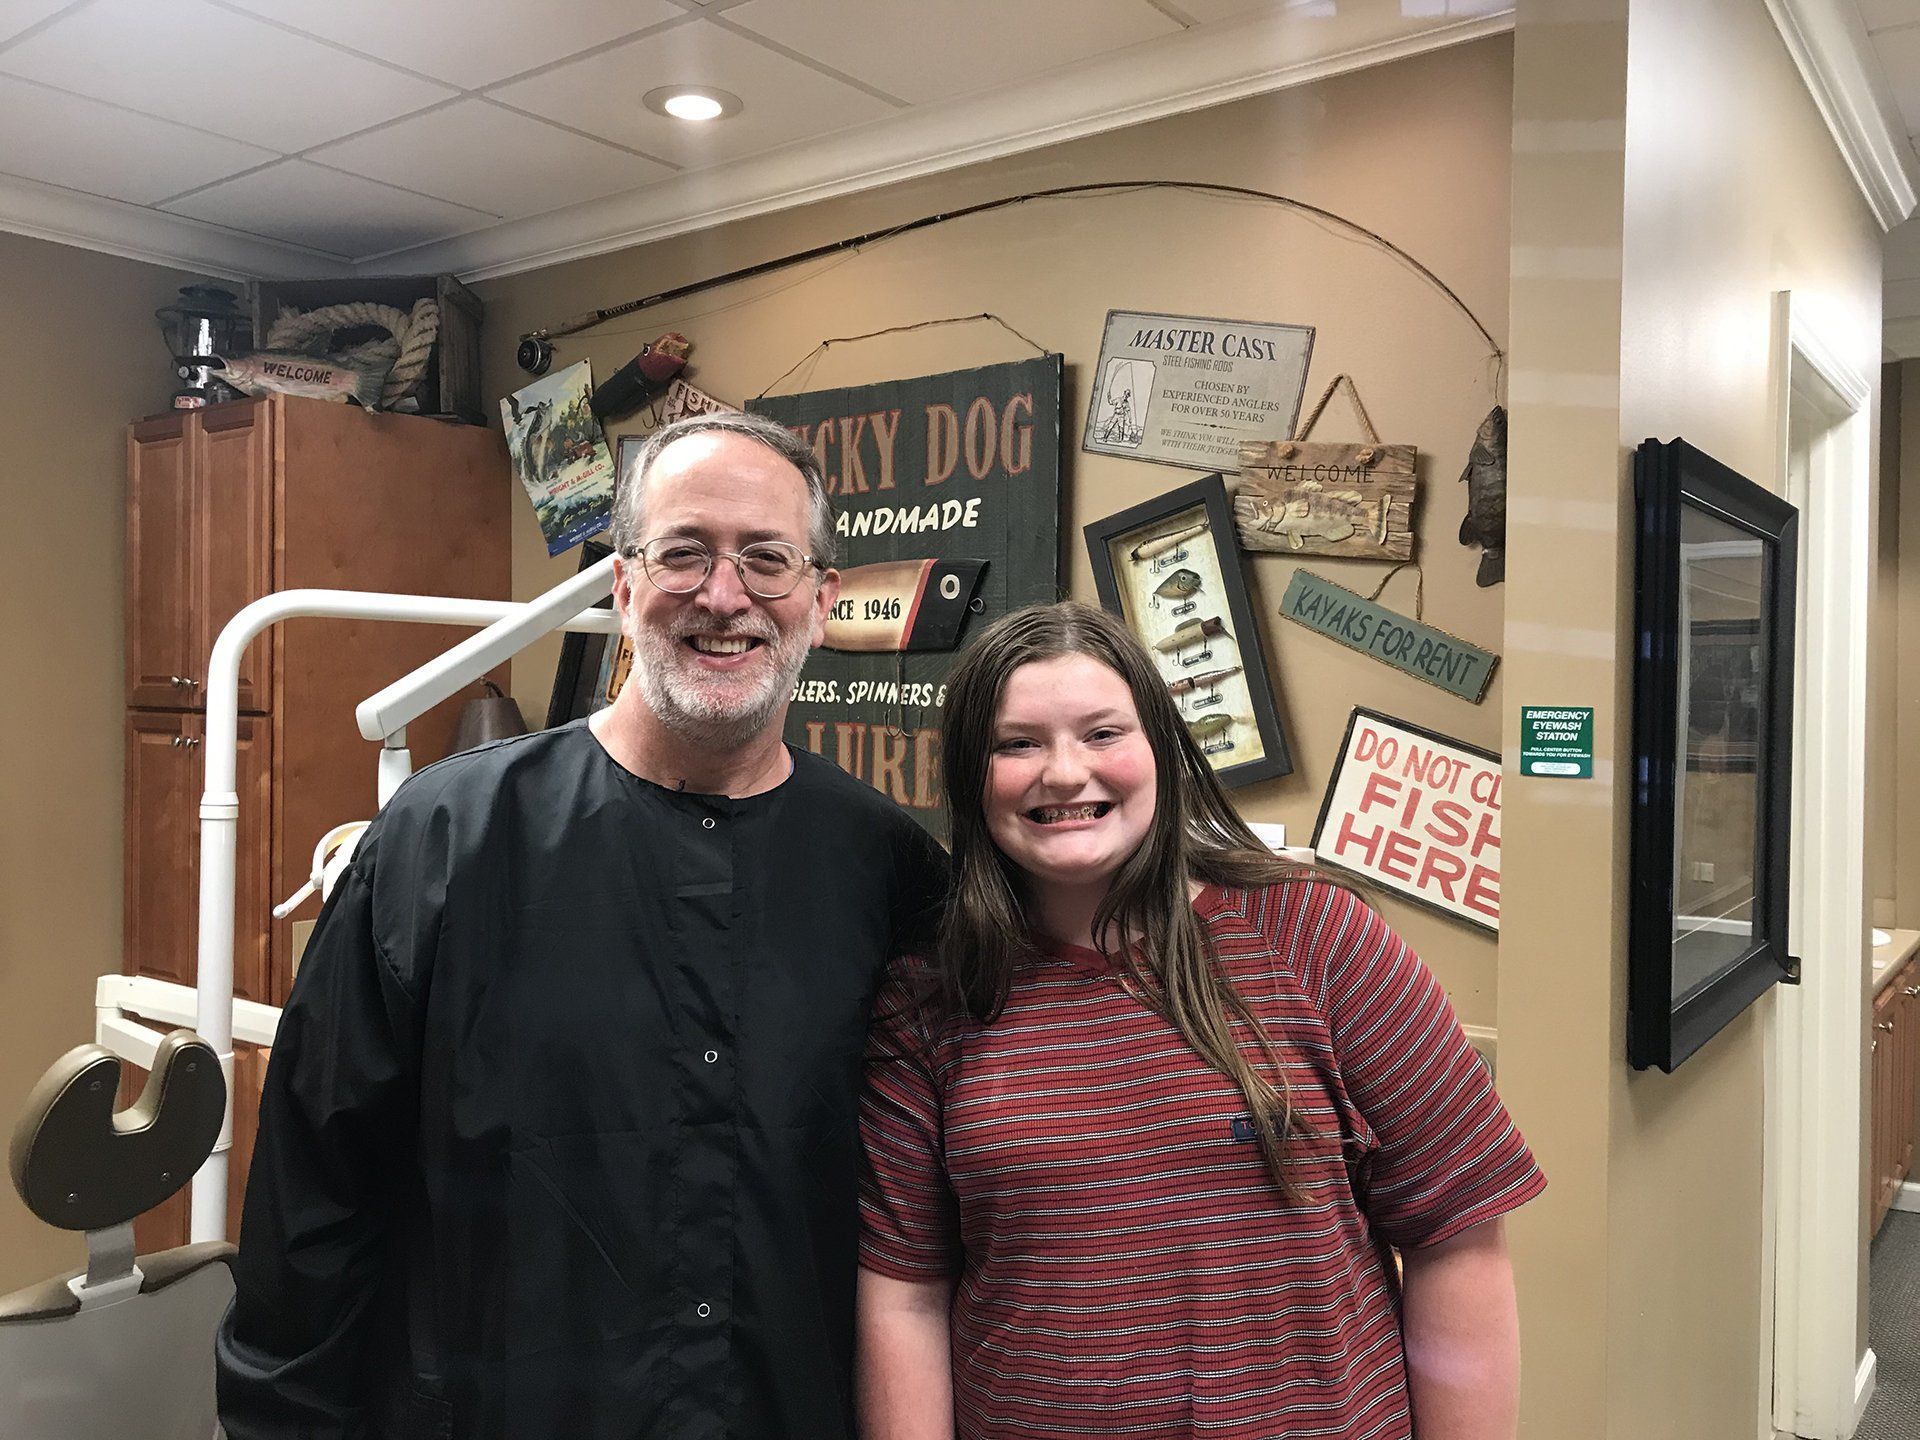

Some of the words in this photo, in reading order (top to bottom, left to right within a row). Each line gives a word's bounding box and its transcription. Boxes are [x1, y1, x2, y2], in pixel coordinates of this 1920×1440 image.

[1129, 329, 1215, 356] MASTER
[1222, 333, 1277, 361] CAST
[263, 361, 333, 385] WELCOME
[1162, 355, 1183, 368] STEEL
[1183, 357, 1212, 371] FISHING
[1212, 360, 1234, 373] RODS
[1194, 380, 1235, 393] CHOSEN
[1236, 385, 1250, 395] BY
[1162, 389, 1230, 406] EXPERIENCED
[1231, 398, 1280, 412] ANGLERS
[1171, 402, 1190, 414] FOR
[1191, 405, 1218, 418] OVER
[1220, 409, 1231, 419] 50
[1232, 410, 1265, 423] YEARS
[924, 392, 1034, 487] DOG
[1160, 428, 1172, 437] WE
[1172, 429, 1198, 440] THINK
[1199, 433, 1215, 442] YOU
[1216, 435, 1236, 446] WILL
[1161, 439, 1181, 449] WITH
[1181, 441, 1206, 452] THEIR
[1267, 463, 1375, 484] WELCOME
[835, 497, 982, 538] ANDMADE
[827, 599, 854, 621] NCE
[864, 598, 901, 621] 1946
[1293, 585, 1373, 642] KAYAKS
[1369, 619, 1416, 663] FOR
[1413, 638, 1479, 685] RENT
[845, 681, 934, 707] SPINNERS
[935, 684, 947, 708] &
[1526, 710, 1590, 720] EMERGENCY
[1532, 721, 1582, 730] EYEWASH
[1536, 731, 1578, 741] STATION
[1354, 728, 1399, 770] DO
[1402, 744, 1471, 795] NOT
[1334, 812, 1500, 919] HERE
